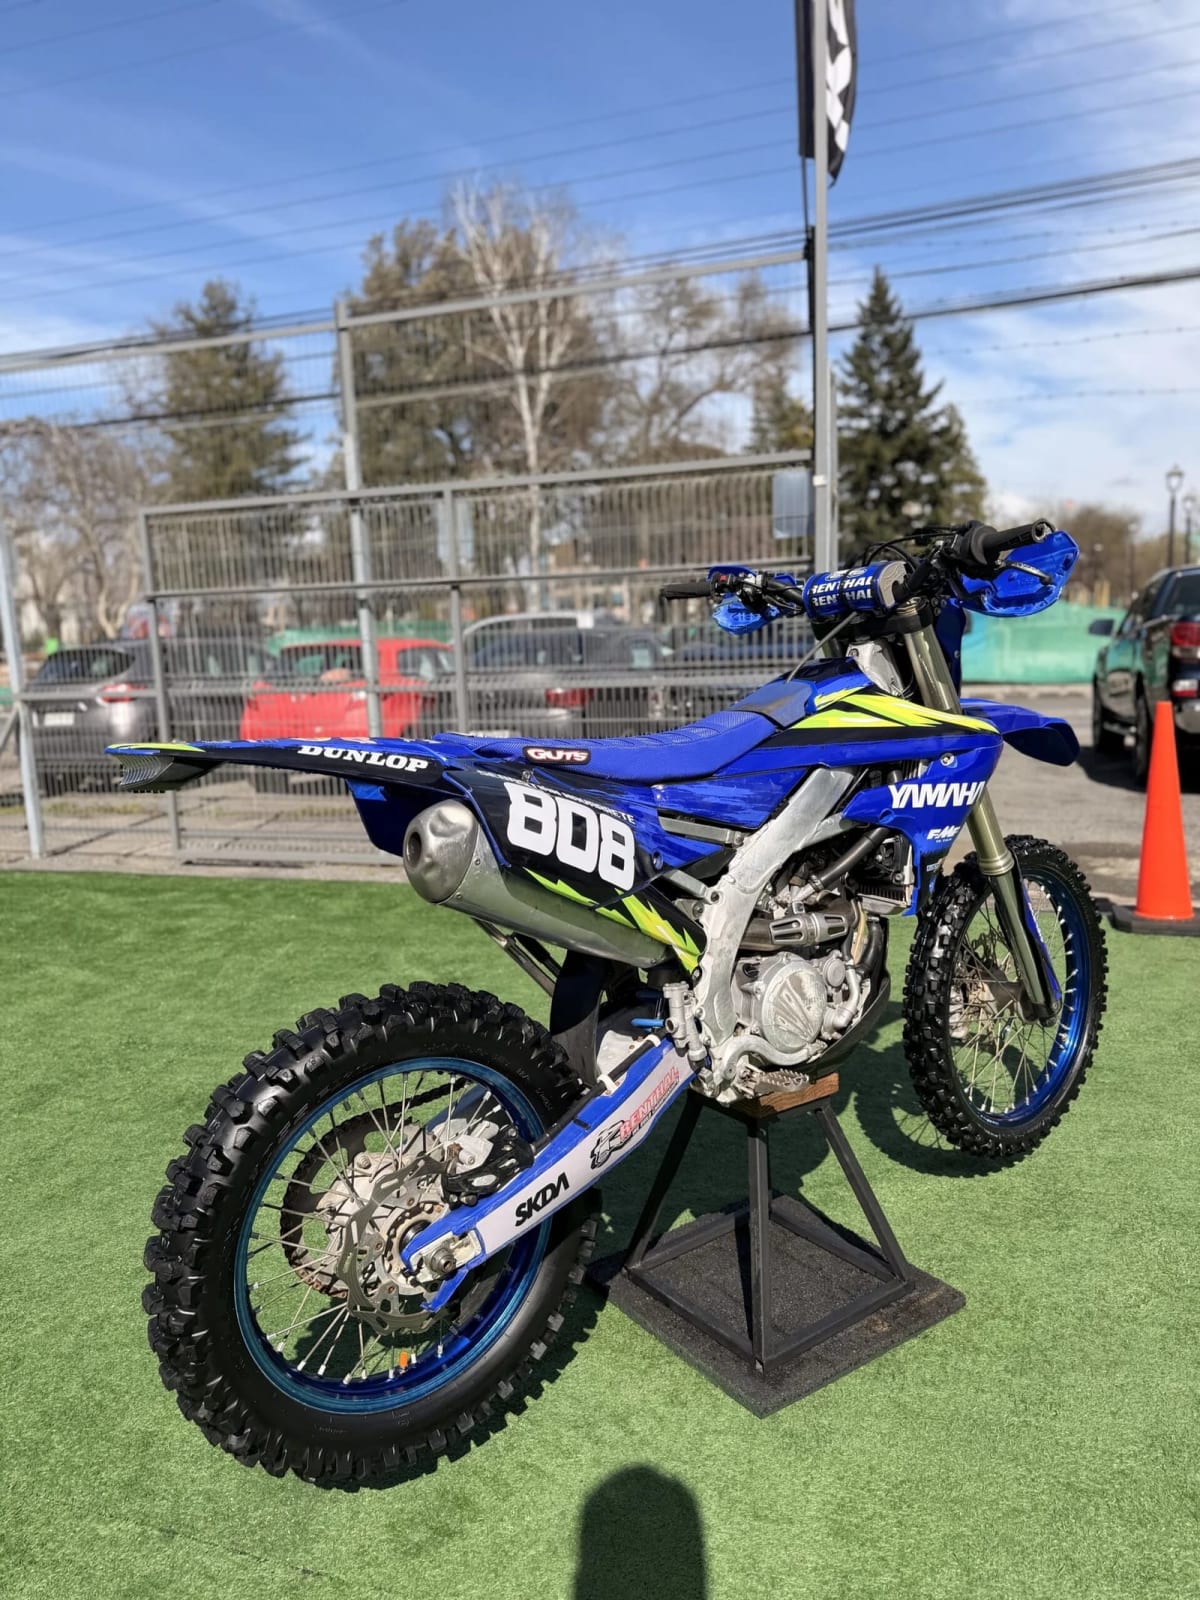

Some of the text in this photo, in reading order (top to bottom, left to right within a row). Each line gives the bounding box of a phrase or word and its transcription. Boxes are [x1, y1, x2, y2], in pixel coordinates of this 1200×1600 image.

[811, 588, 873, 607] RENHAL
[297, 745, 428, 772] DUNLOP
[526, 748, 588, 762] GUTS
[504, 781, 635, 891] 808
[926, 825, 960, 840] FMF
[619, 1066, 680, 1142] RENTHAL
[515, 1172, 570, 1227] SKDA
